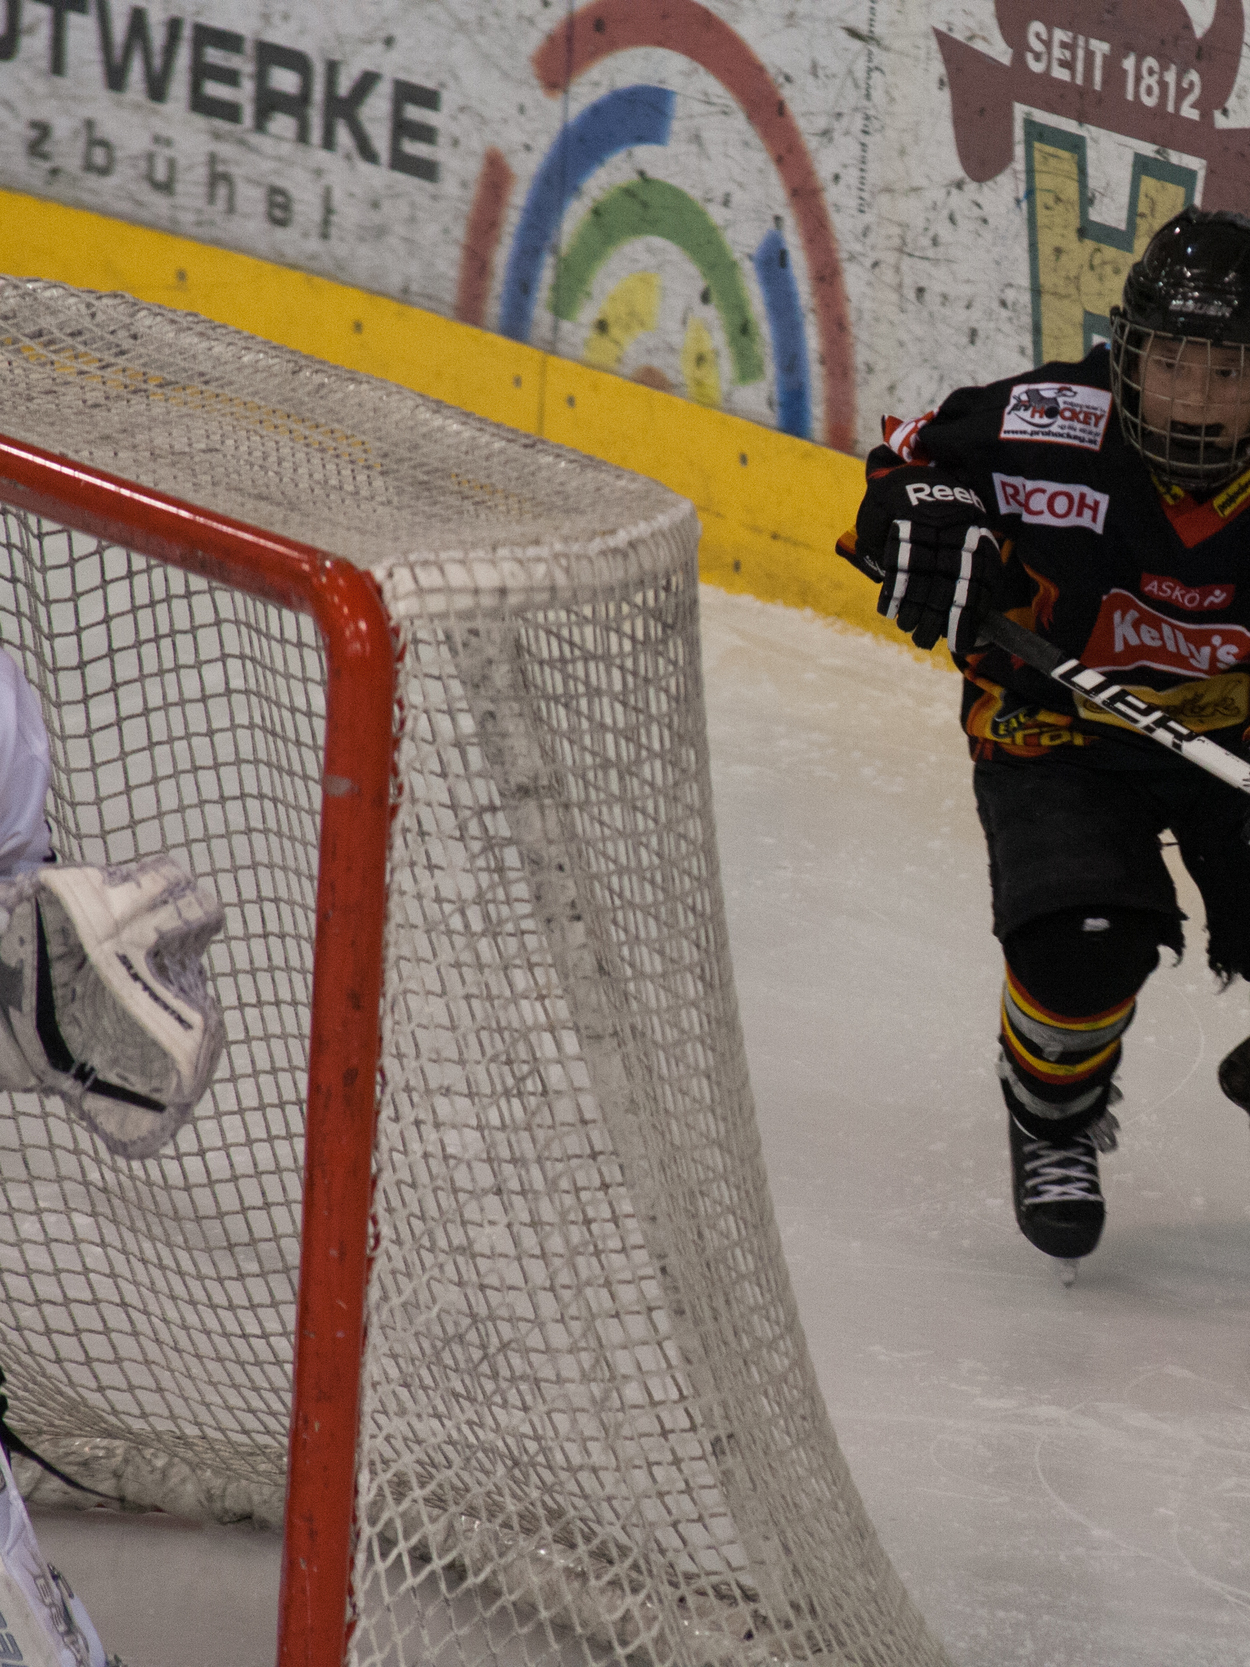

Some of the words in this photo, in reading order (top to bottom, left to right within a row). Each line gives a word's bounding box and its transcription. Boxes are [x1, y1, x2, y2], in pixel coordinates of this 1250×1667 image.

[1024, 20, 1112, 92] SEIT
[1121, 51, 1202, 122] 1812
[1143, 578, 1200, 608] ASKÖ
[1112, 608, 1240, 671] Kelly's
